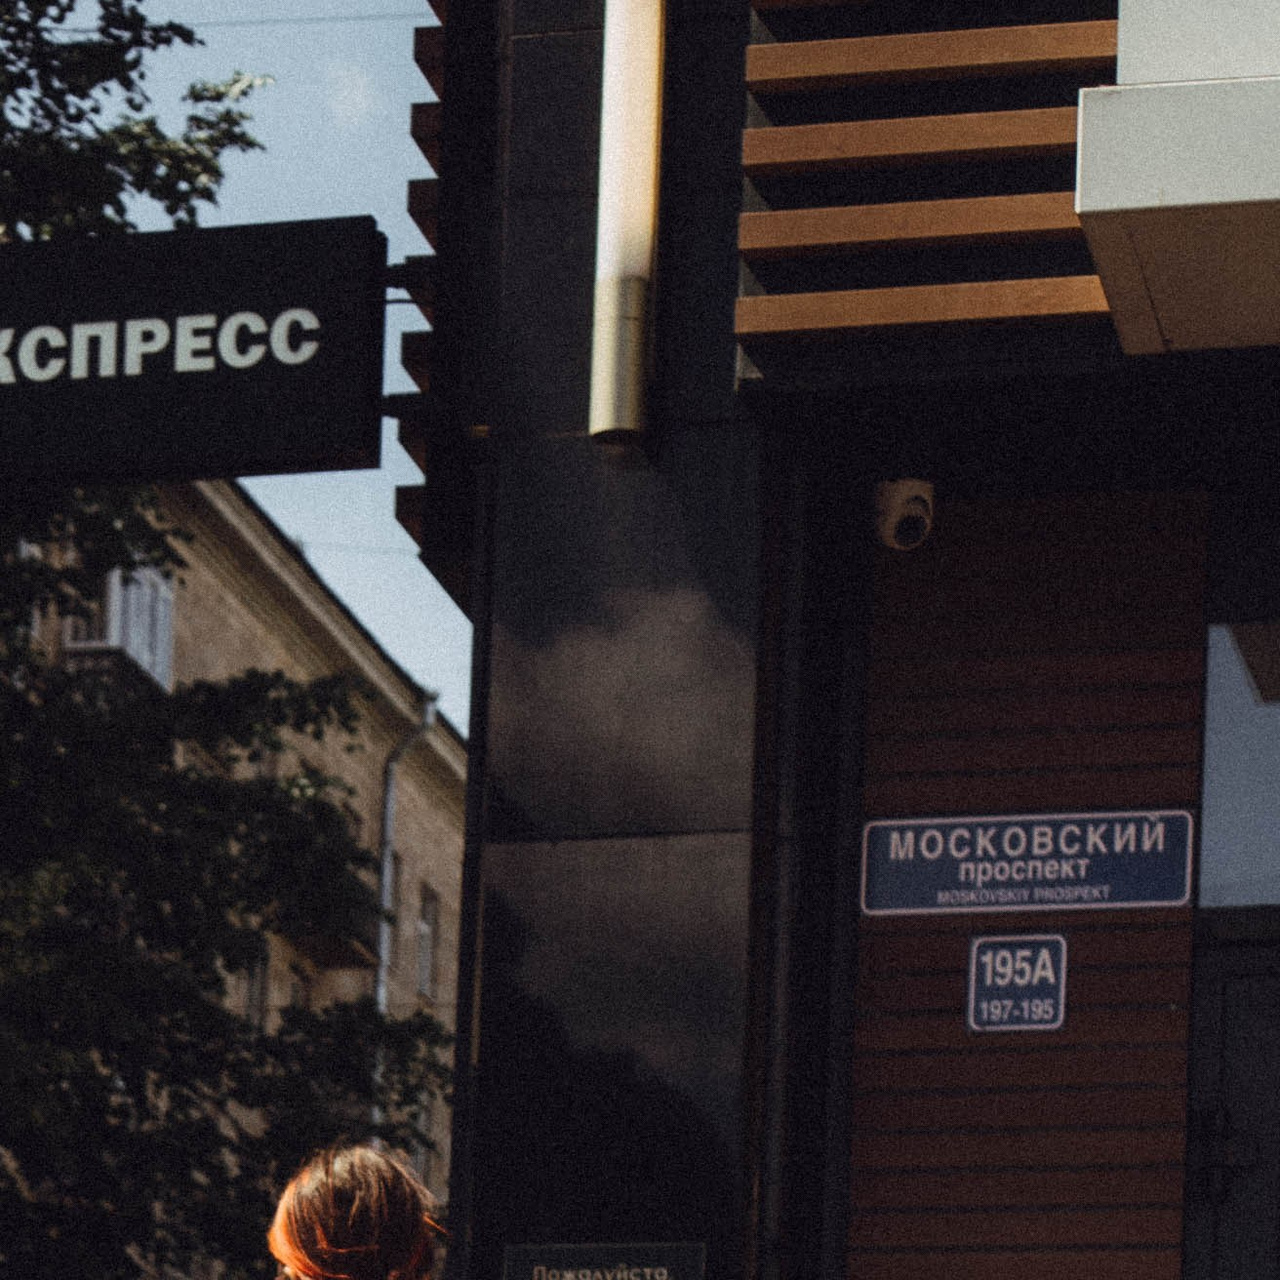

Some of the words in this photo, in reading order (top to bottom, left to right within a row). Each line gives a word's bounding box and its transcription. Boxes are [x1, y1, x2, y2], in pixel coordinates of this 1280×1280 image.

[888, 815, 1167, 861] МОСКОВСКИЙ
[958, 858, 1091, 887] проспект
[979, 999, 1055, 1022] 197-195
